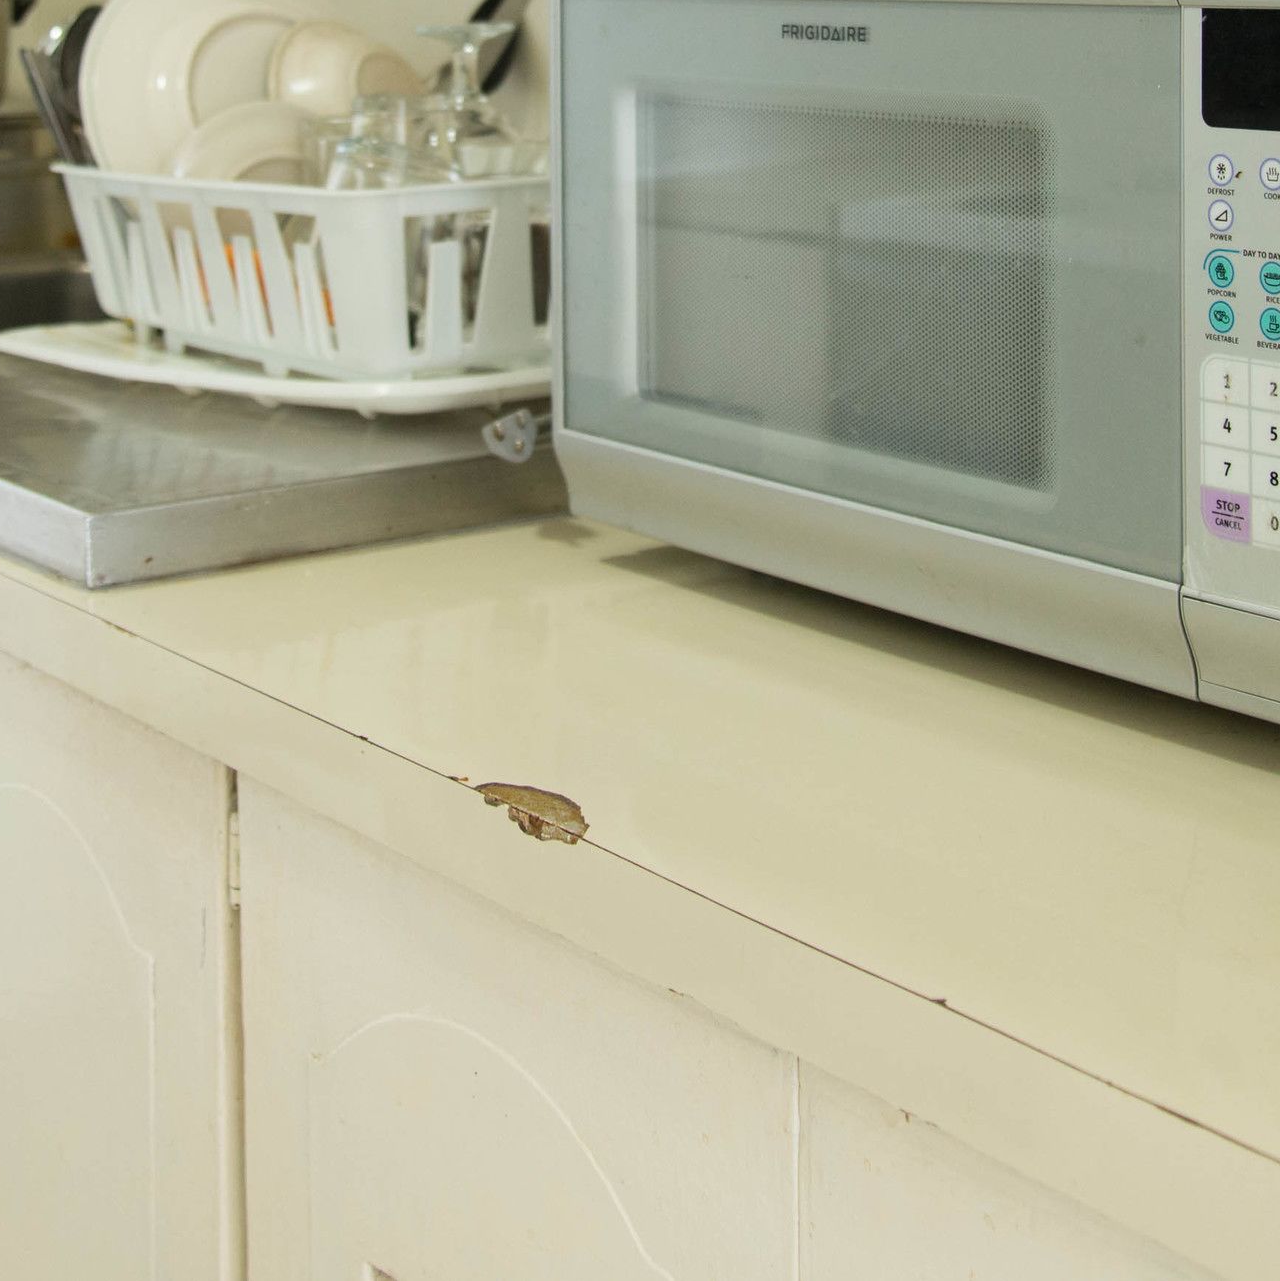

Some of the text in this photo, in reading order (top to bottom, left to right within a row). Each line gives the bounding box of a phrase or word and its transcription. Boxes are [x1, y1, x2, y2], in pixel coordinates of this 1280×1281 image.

[781, 24, 867, 42] FRIGIDAIRE
[1207, 187, 1235, 196] DEFROST
[1209, 233, 1233, 241] POWER
[1242, 249, 1256, 258] DAY
[1258, 251, 1267, 259] TO
[1207, 288, 1237, 298] POPCORN
[1265, 296, 1280, 304] RICE
[1204, 333, 1239, 344] VEGETABLE
[1269, 382, 1278, 397] 2
[1222, 418, 1232, 434] 4
[1270, 426, 1278, 441] 5
[1223, 461, 1232, 477] 7
[1269, 471, 1279, 487] 8
[1216, 499, 1241, 513] STOP
[1215, 517, 1242, 531] CANCEL
[1270, 516, 1279, 531] 0
